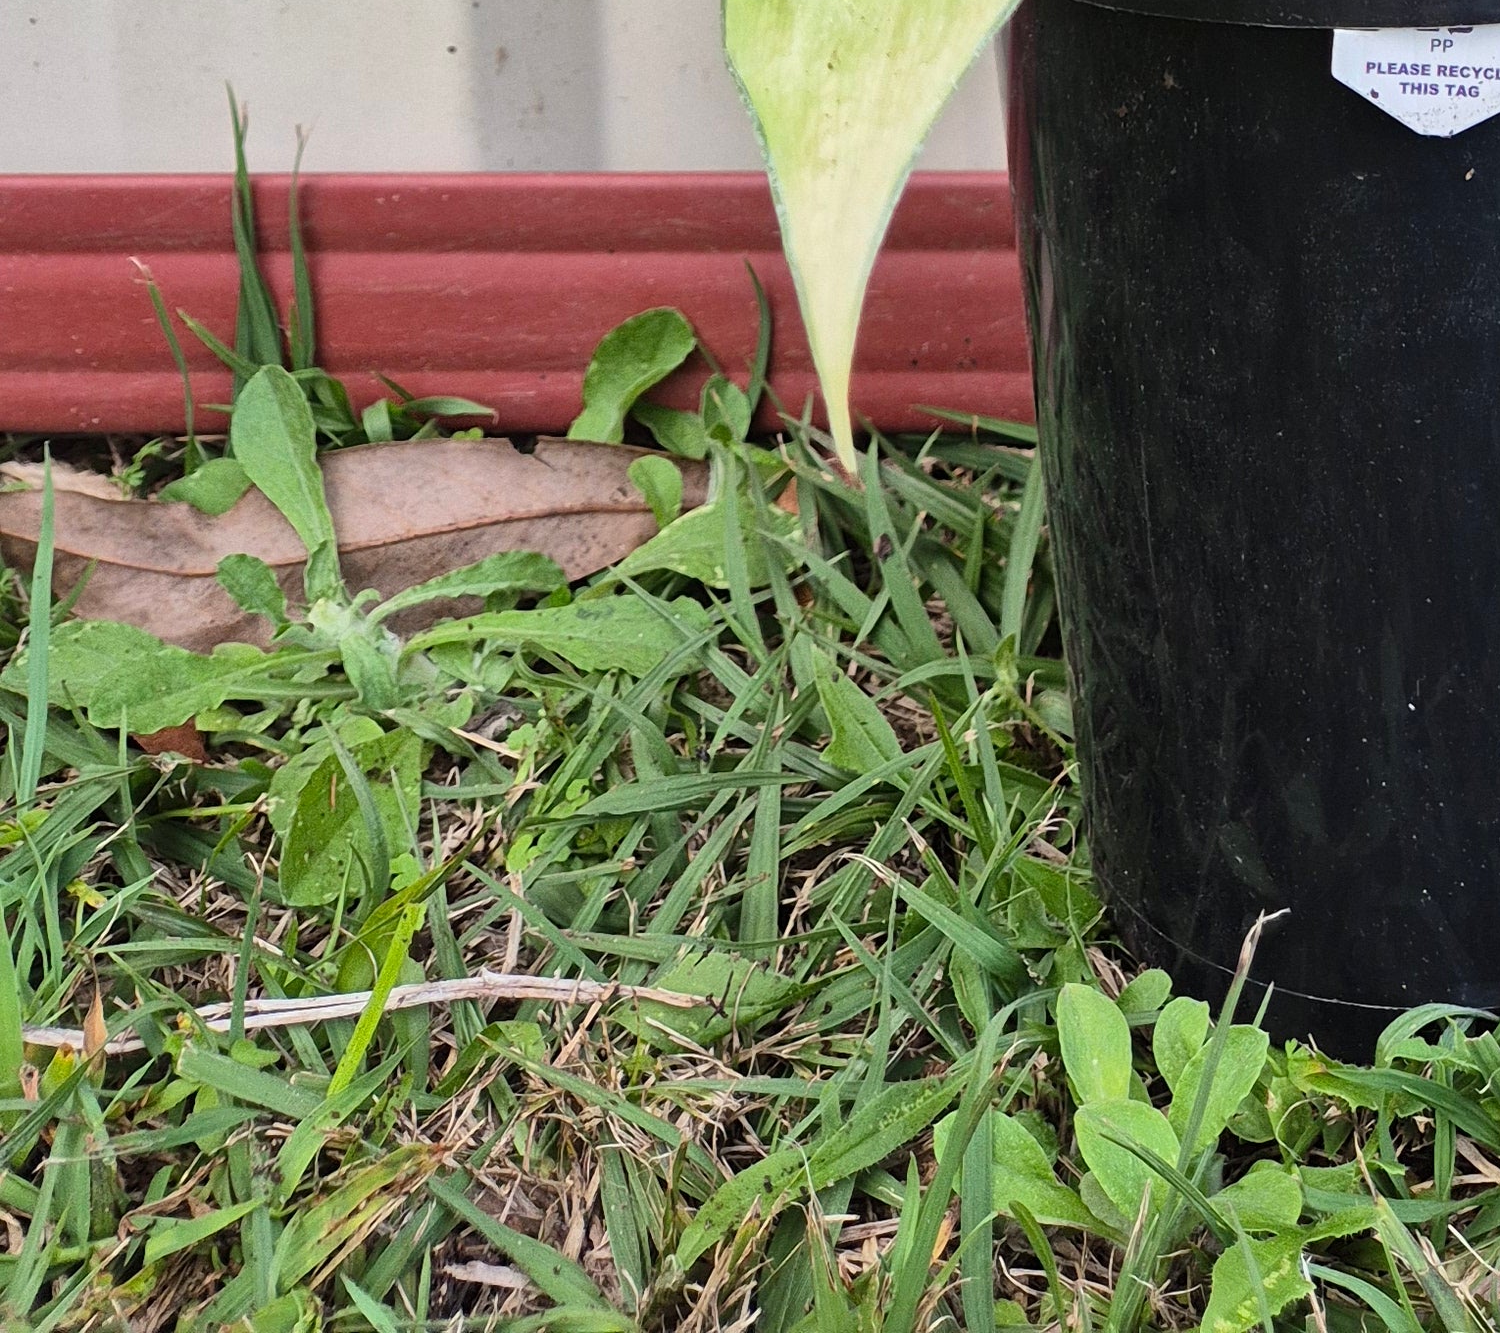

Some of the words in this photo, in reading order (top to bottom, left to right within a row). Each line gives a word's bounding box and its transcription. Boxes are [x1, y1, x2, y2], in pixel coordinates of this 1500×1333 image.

[1430, 38, 1454, 53] PP
[1366, 61, 1431, 77] PLEASE
[1399, 81, 1440, 96] THIS
[1444, 84, 1480, 98] TAG
